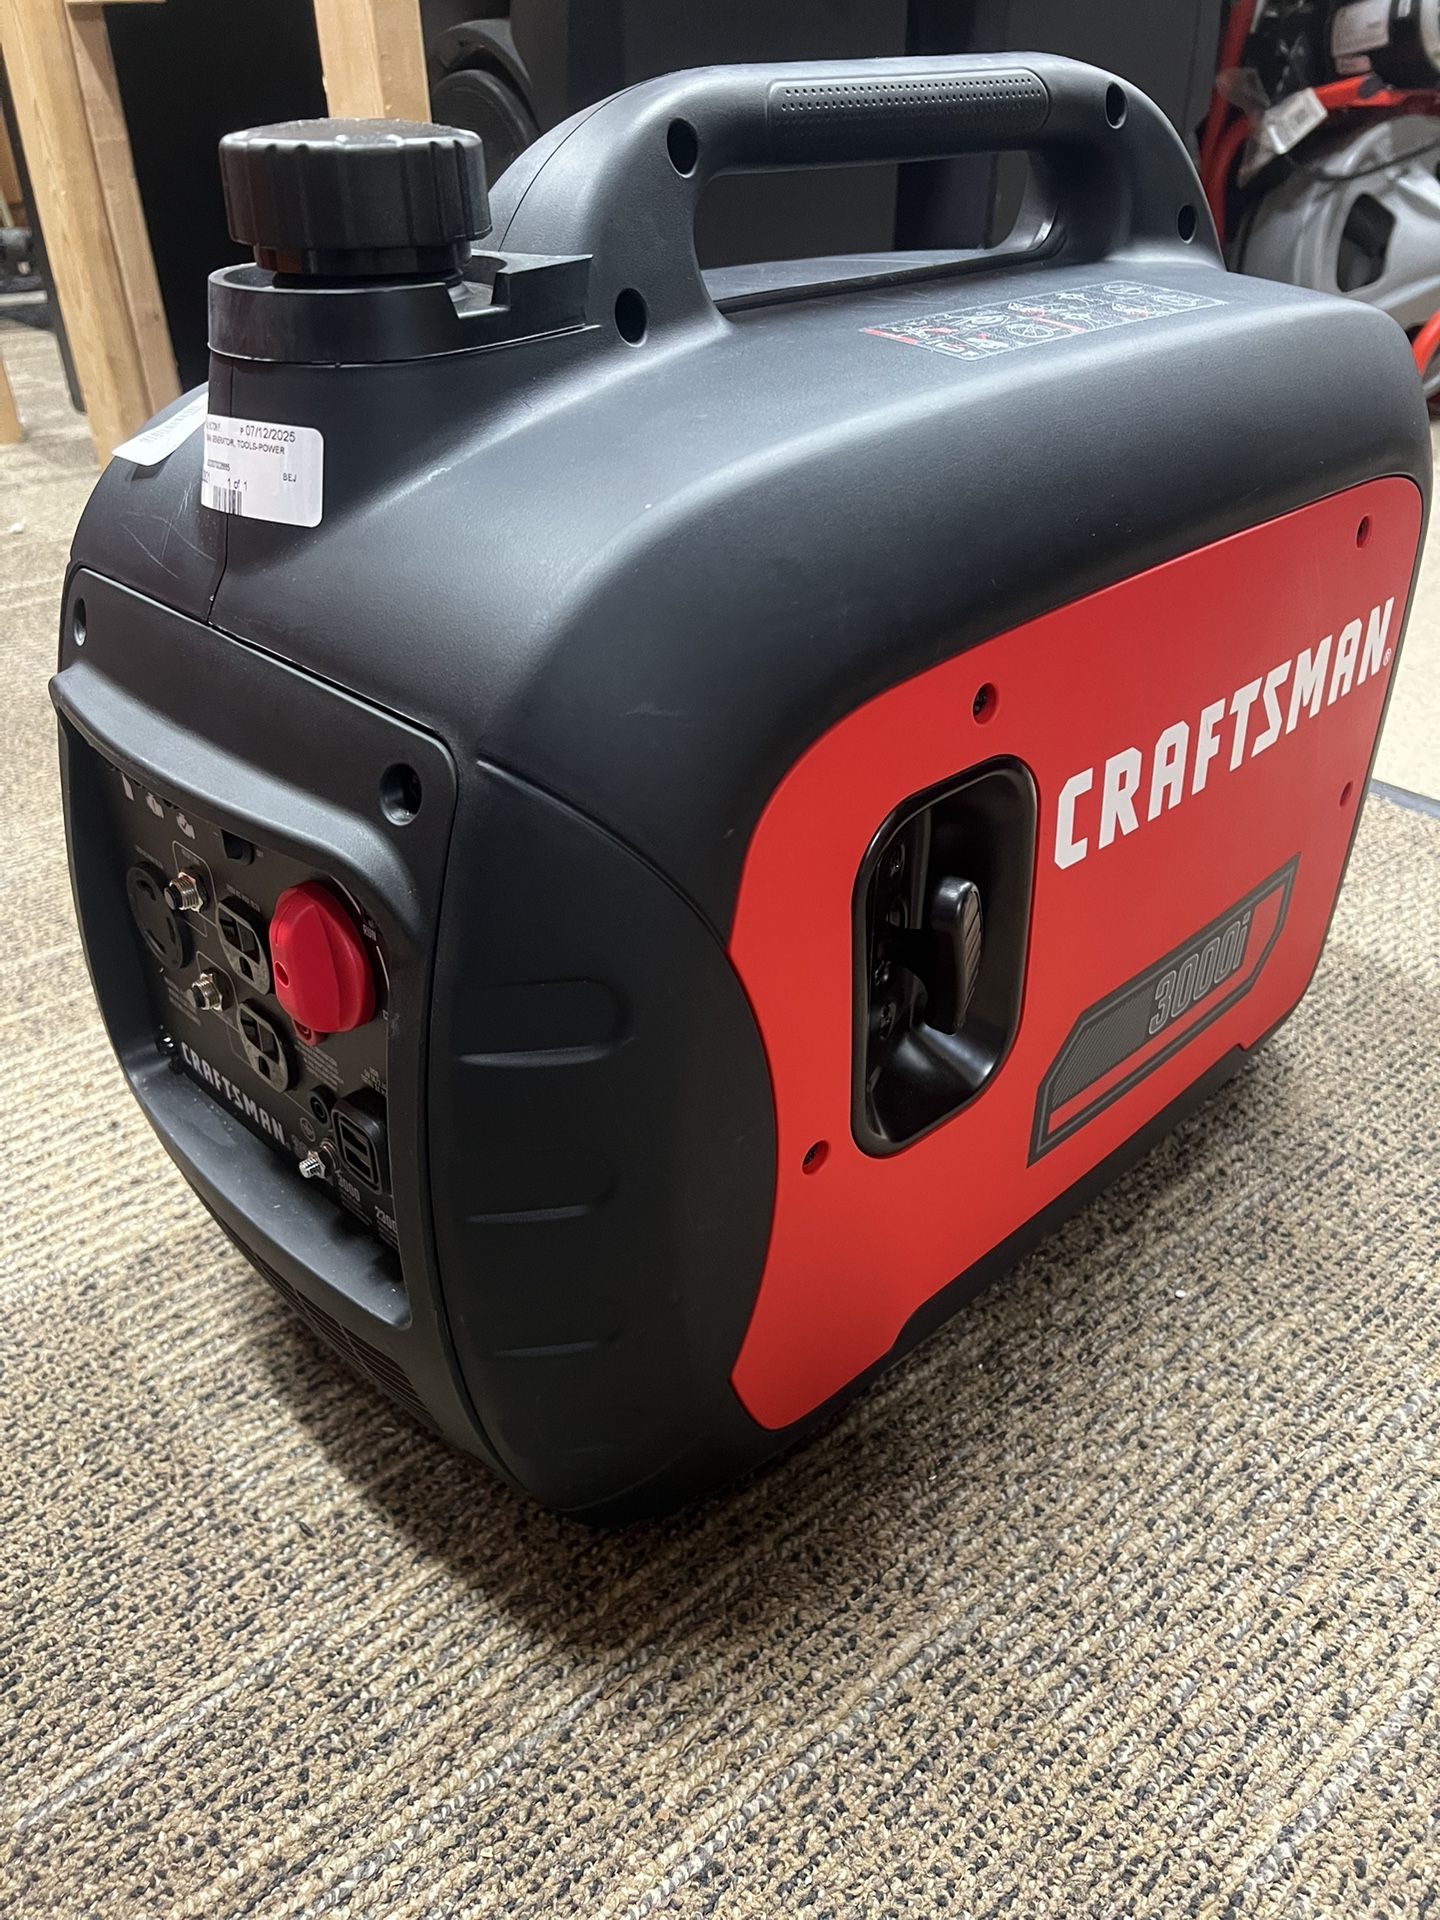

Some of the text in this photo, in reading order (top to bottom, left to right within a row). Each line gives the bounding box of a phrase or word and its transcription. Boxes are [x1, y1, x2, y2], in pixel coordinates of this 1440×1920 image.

[245, 424, 295, 443] 07/12/2025
[282, 472, 296, 482] BEJ
[1054, 596, 1394, 870] CRAFTSMAN
[1149, 911, 1251, 1034] 3000i
[181, 1041, 286, 1146] CRAFTSMAN
